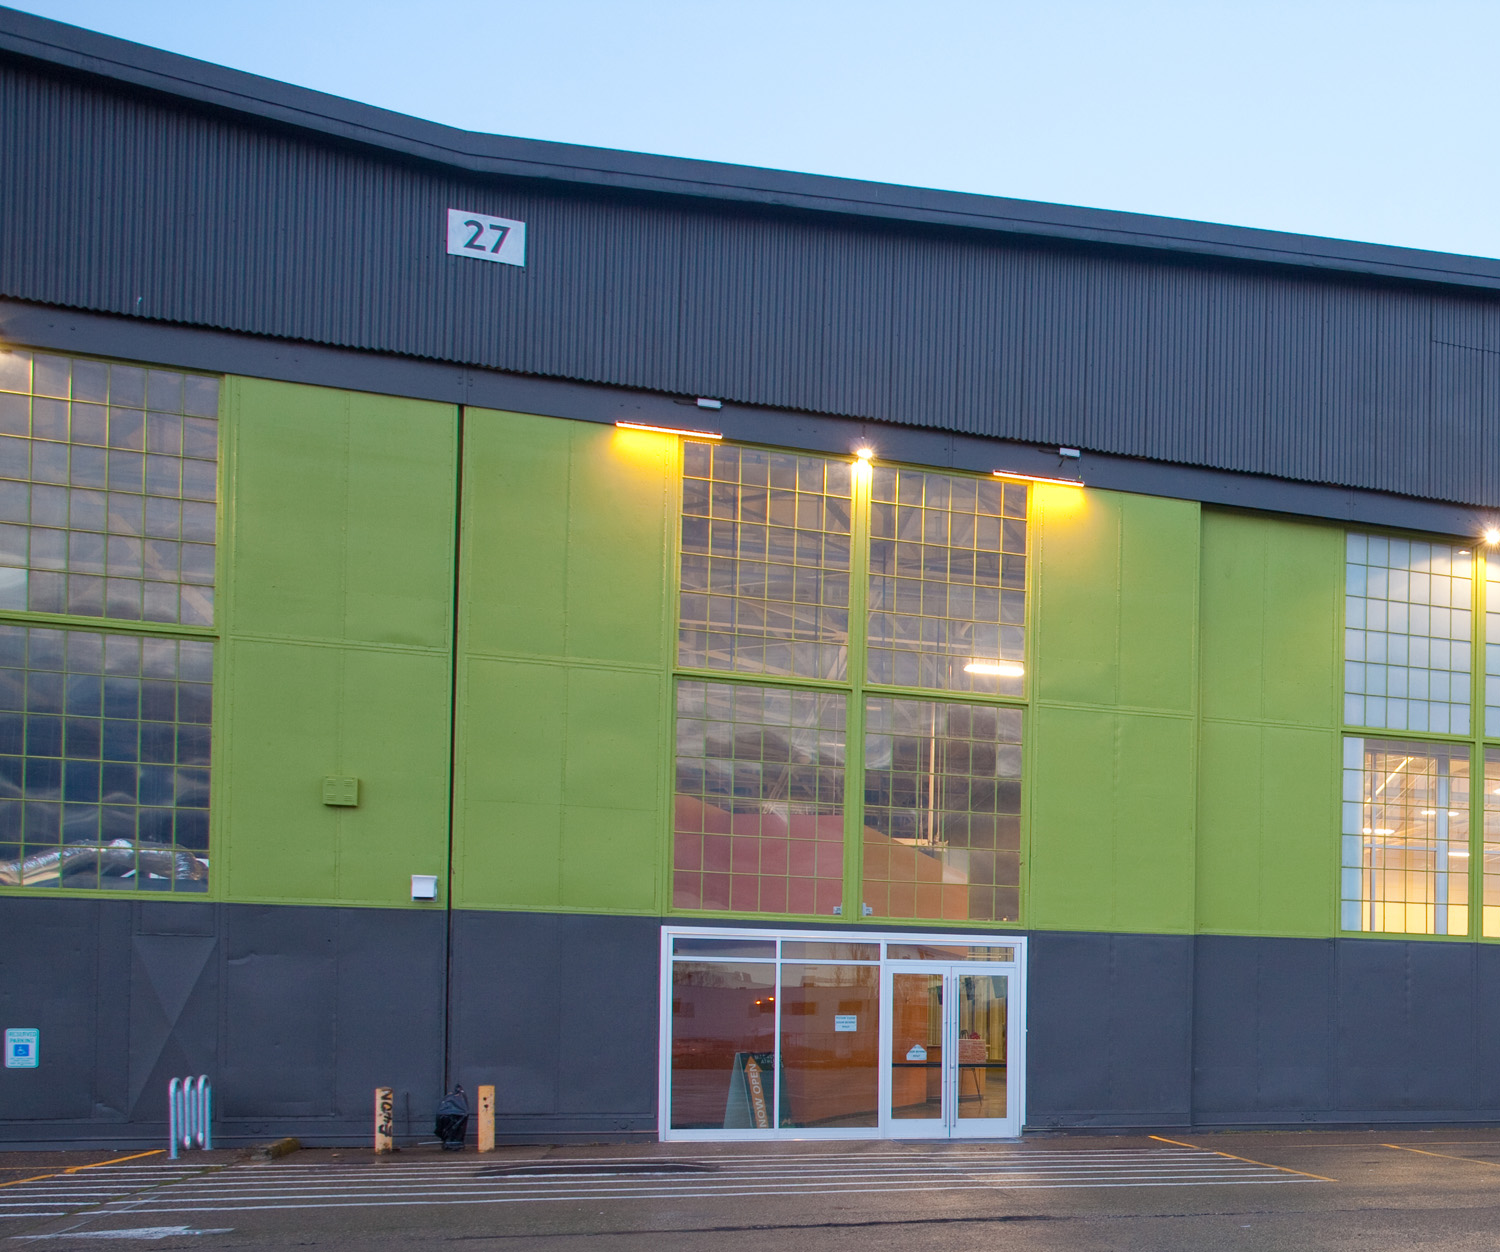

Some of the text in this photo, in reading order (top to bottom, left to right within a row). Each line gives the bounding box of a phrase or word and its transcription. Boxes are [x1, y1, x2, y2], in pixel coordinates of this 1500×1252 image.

[463, 219, 511, 254] 27
[749, 1064, 767, 1127] NOW OPEN
